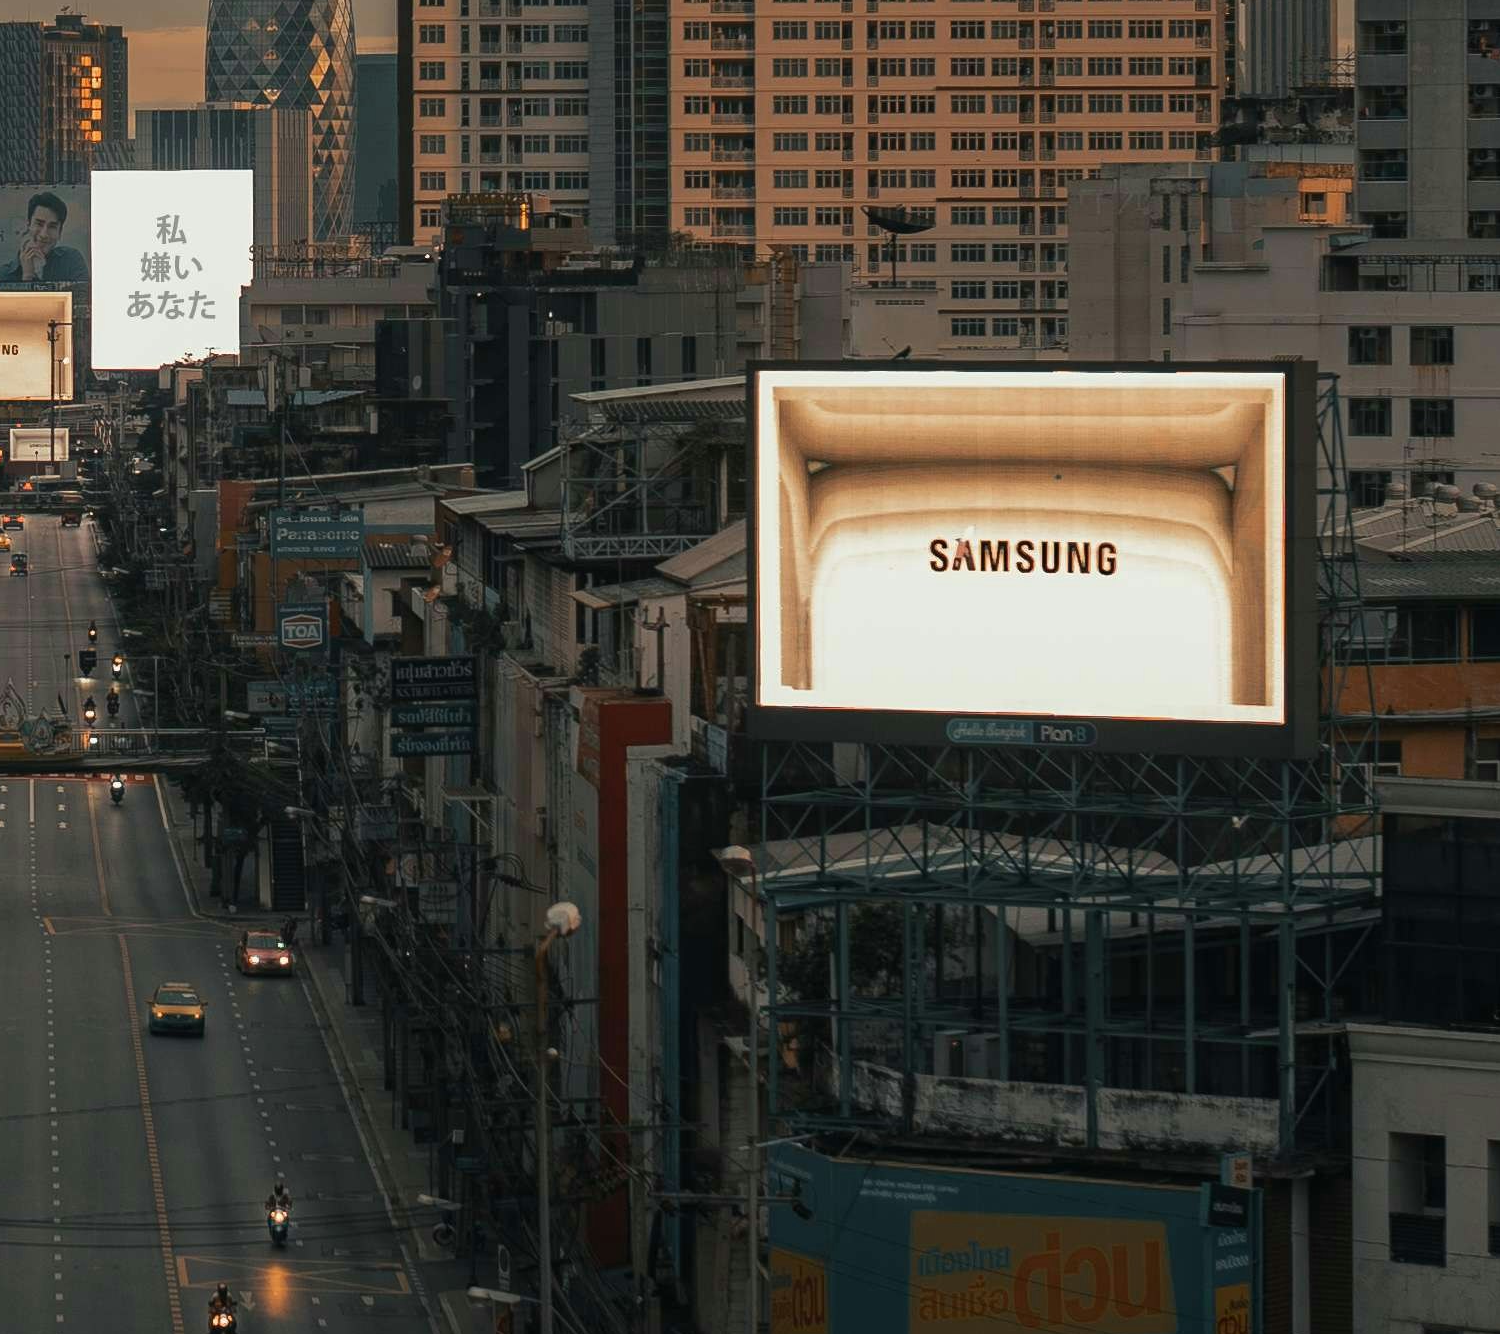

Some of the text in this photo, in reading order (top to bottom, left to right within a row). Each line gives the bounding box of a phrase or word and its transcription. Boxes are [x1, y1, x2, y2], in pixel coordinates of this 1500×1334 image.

[154, 213, 188, 245] 私
[139, 251, 204, 283] 嫌い
[126, 290, 217, 320] あなた
[275, 527, 361, 541] Panasonic
[929, 538, 1118, 576] SAMSUNG
[284, 625, 319, 640] TOA
[1013, 1230, 1162, 1328] ด่วน
[919, 1275, 1009, 1322] สินเชื่อ
